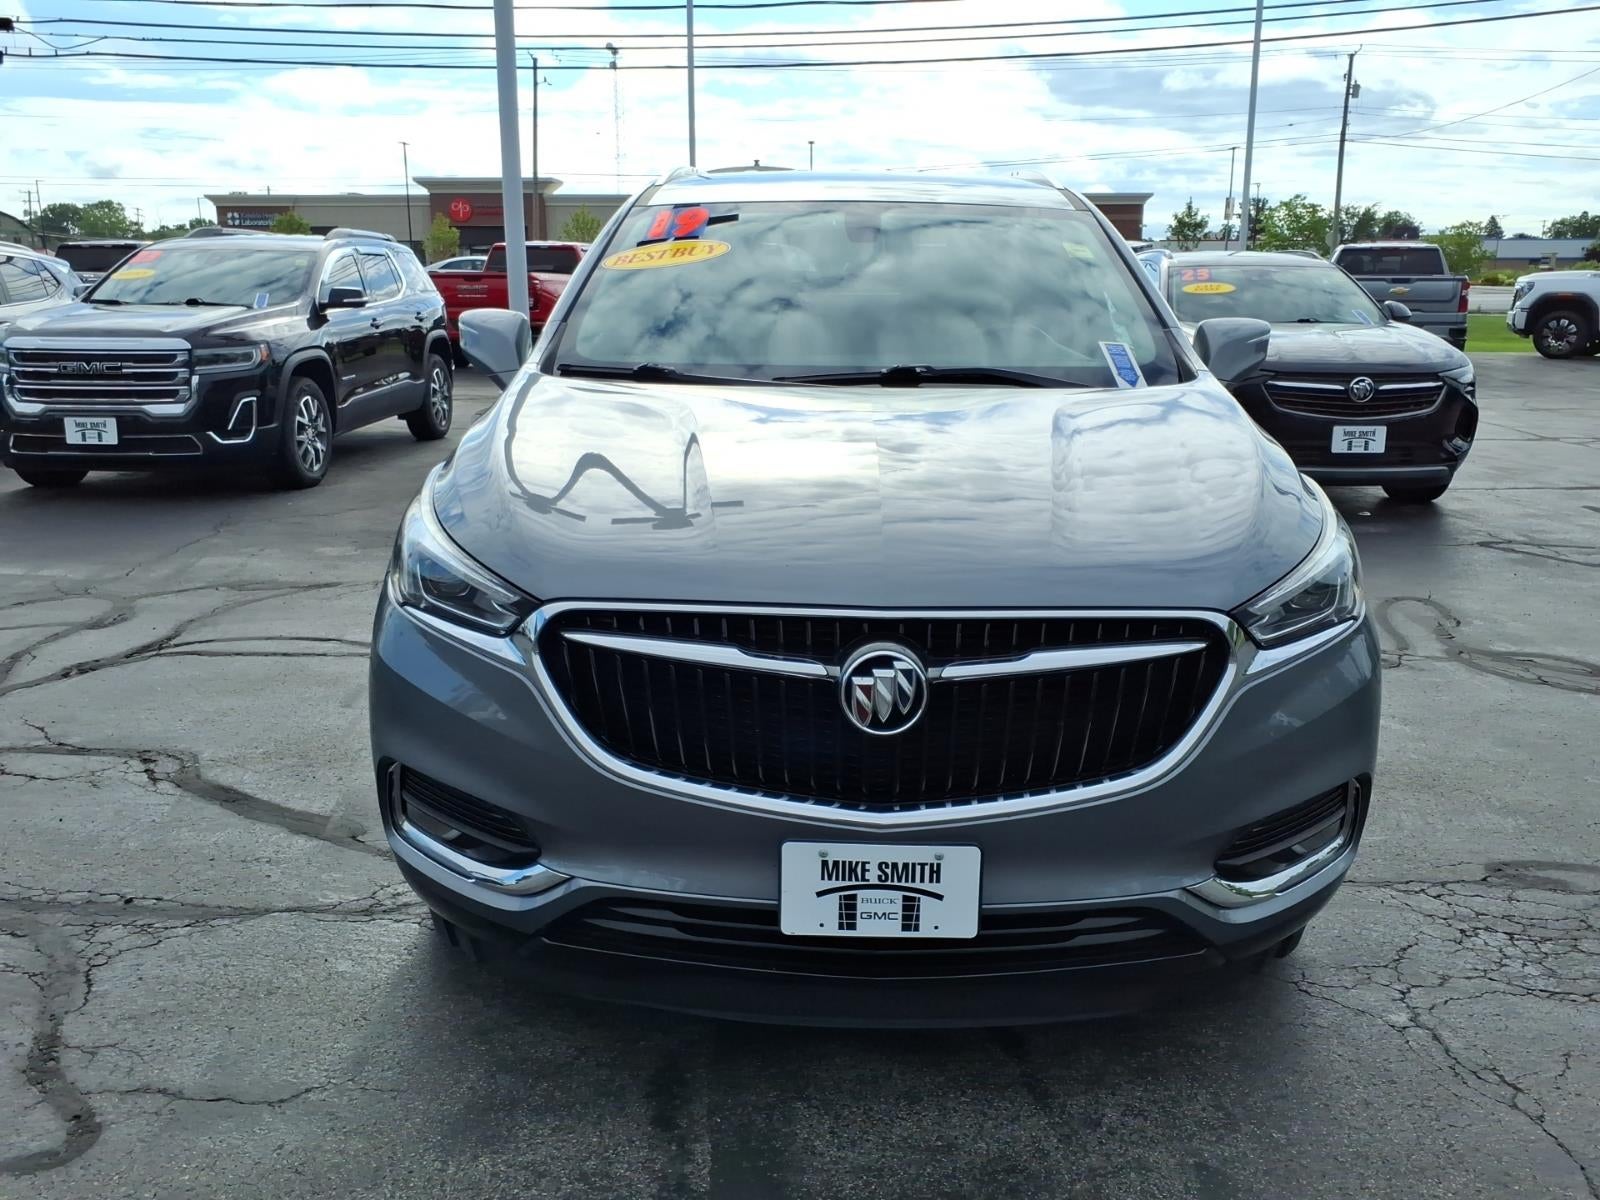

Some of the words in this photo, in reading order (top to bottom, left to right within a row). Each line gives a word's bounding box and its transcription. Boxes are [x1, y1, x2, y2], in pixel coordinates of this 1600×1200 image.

[647, 207, 710, 239] 19
[58, 362, 121, 374] GMC
[1343, 430, 1357, 438] MIKE
[1358, 430, 1376, 438] SMITH
[820, 859, 870, 882] MIKE
[877, 861, 942, 884] SMITH
[860, 897, 897, 905] BUICK
[860, 911, 899, 921] GMC
